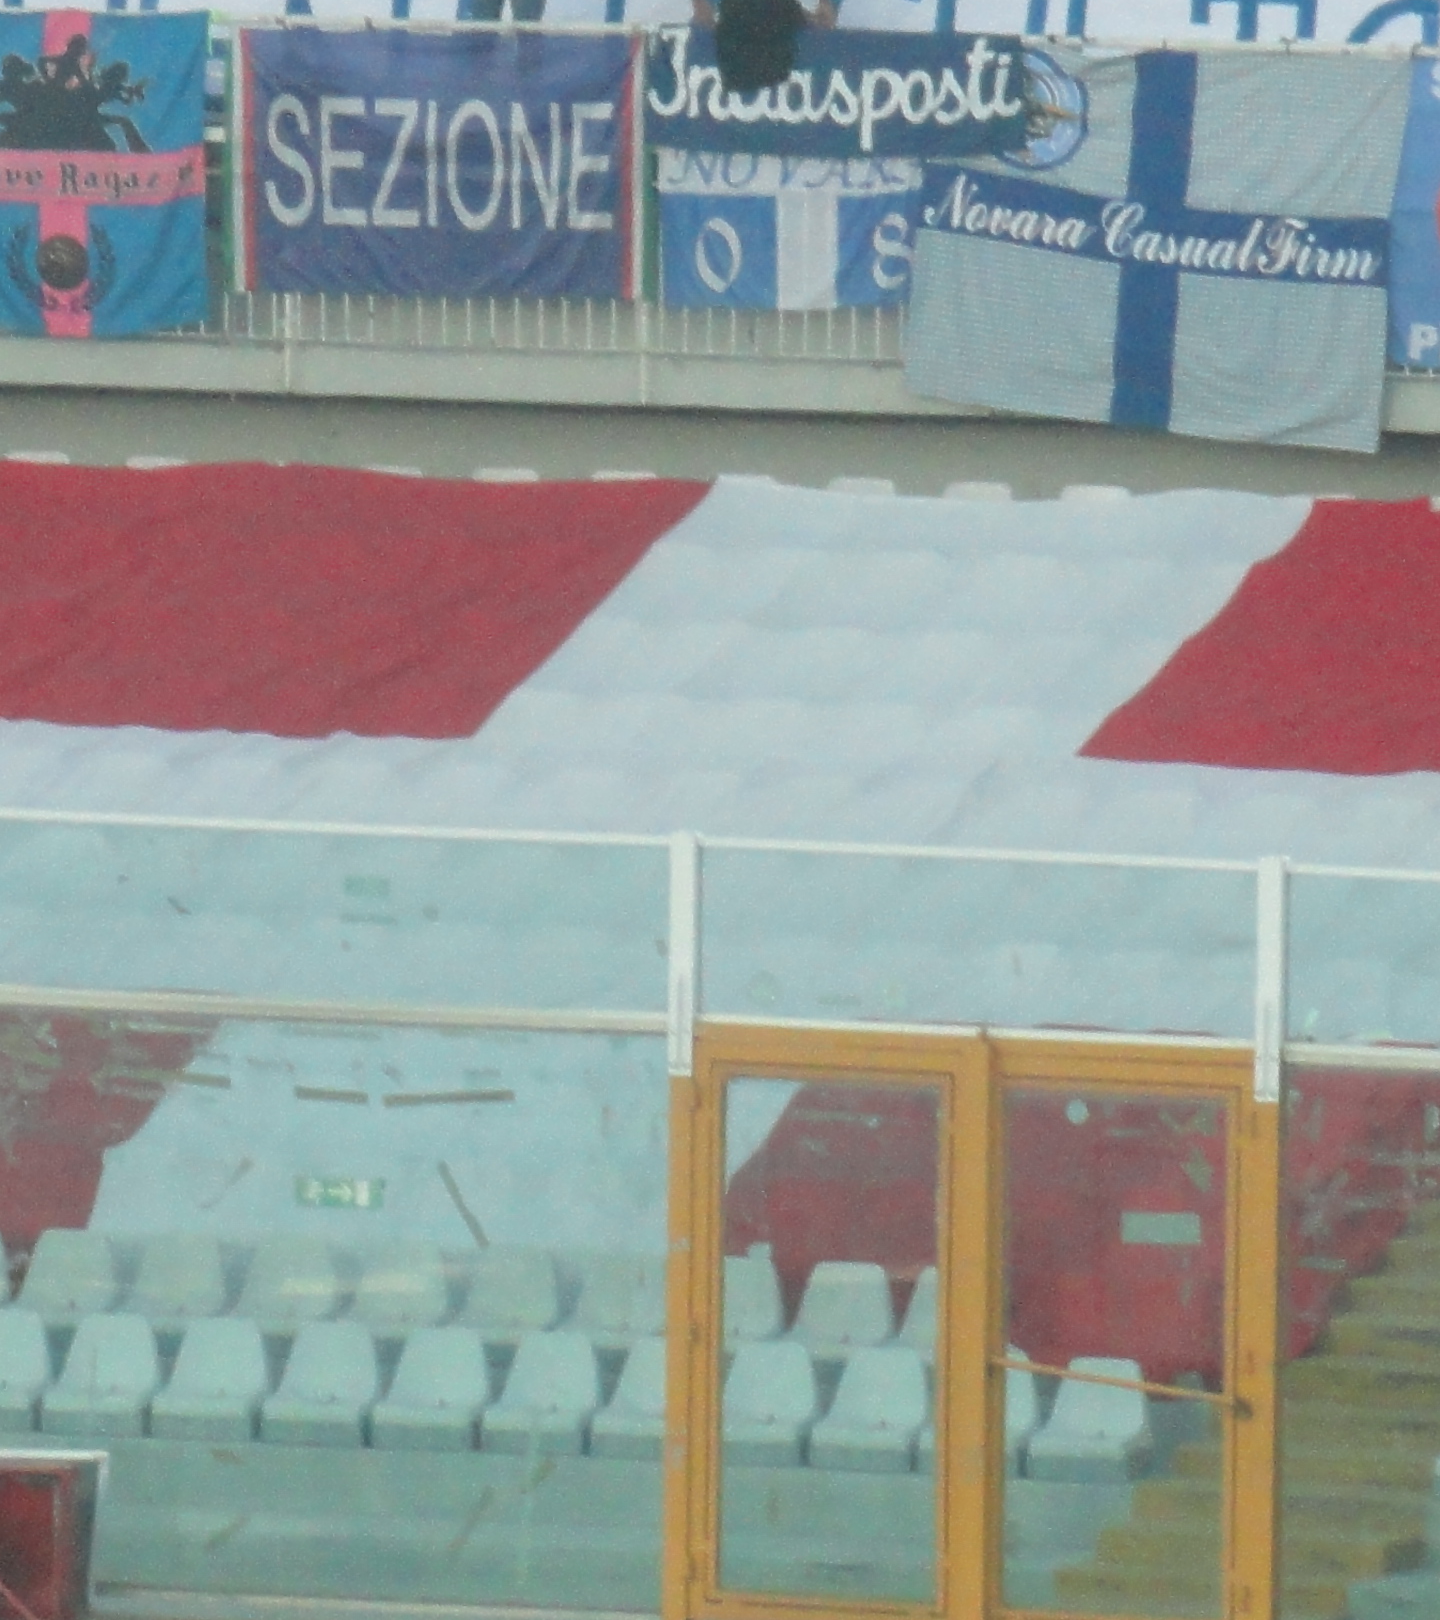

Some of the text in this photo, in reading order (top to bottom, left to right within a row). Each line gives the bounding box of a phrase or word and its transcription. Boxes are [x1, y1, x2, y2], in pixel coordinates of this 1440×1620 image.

[265, 93, 616, 232] SEZIONE
[923, 174, 1382, 281] Novara Casual Firm
